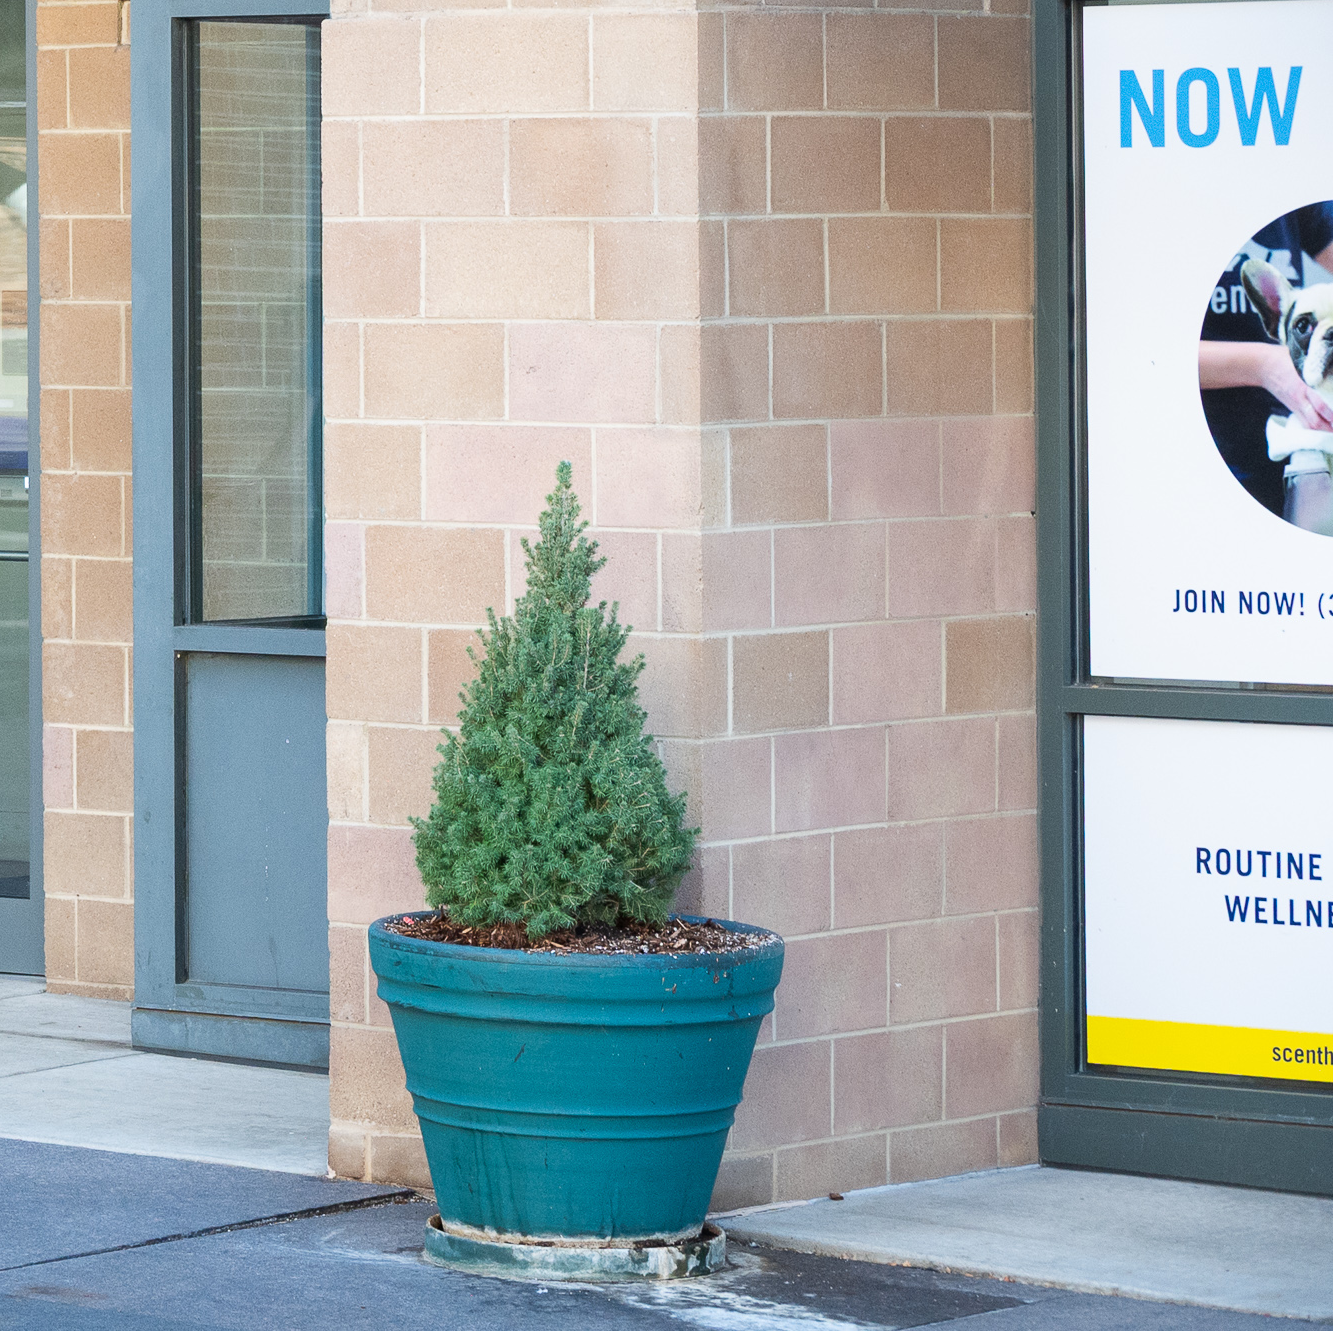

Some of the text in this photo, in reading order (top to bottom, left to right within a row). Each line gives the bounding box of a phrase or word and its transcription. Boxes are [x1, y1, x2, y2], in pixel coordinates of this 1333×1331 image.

[1120, 66, 1303, 148] NOW
[1173, 589, 1225, 613] JOIN
[1239, 591, 1304, 616] NOW!
[1196, 847, 1322, 881] ROUTINE
[1272, 1046, 1333, 1065] scenth
